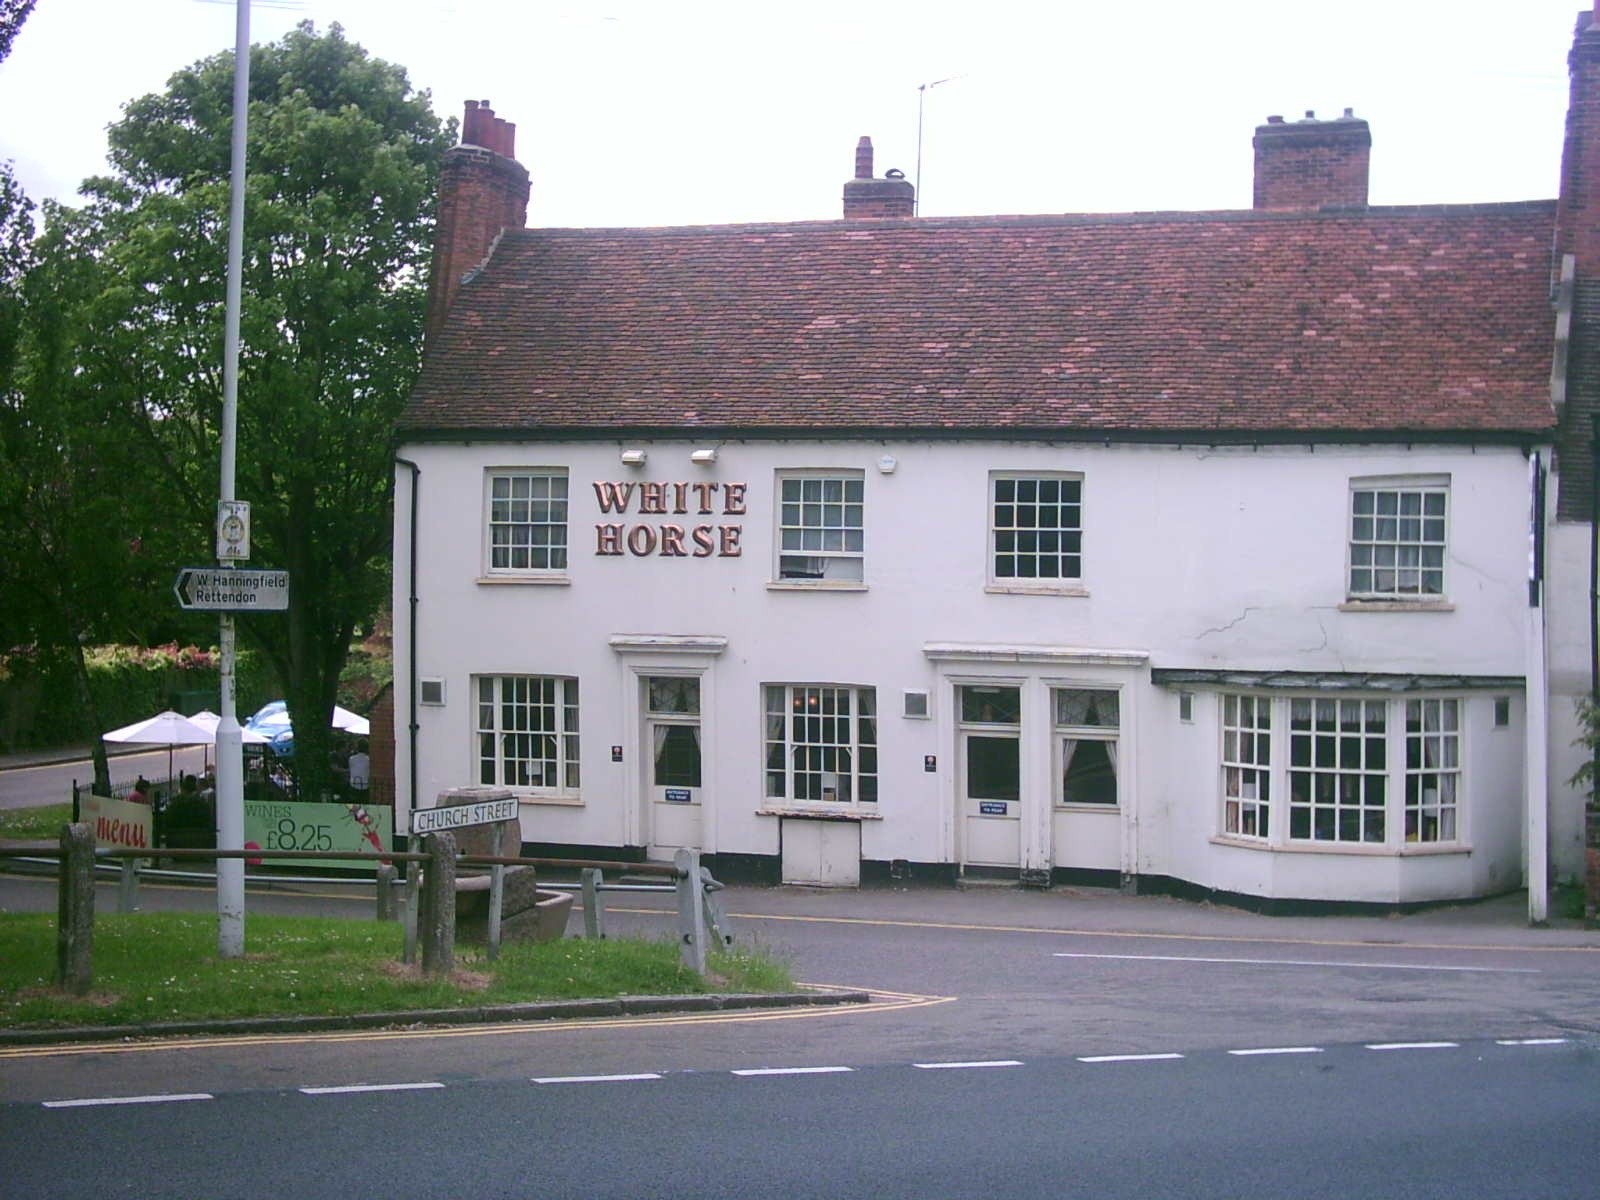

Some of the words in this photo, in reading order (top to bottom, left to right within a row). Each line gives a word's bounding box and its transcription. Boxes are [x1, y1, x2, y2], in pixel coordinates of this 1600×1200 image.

[592, 481, 747, 515] WHITE
[595, 523, 742, 558] HORSE
[213, 575, 286, 589] Hanningfield
[245, 805, 292, 818] WINES
[418, 808, 469, 830] CHURCH
[474, 802, 515, 822] STREET
[96, 815, 146, 849] menu
[266, 818, 332, 852] £8.25
